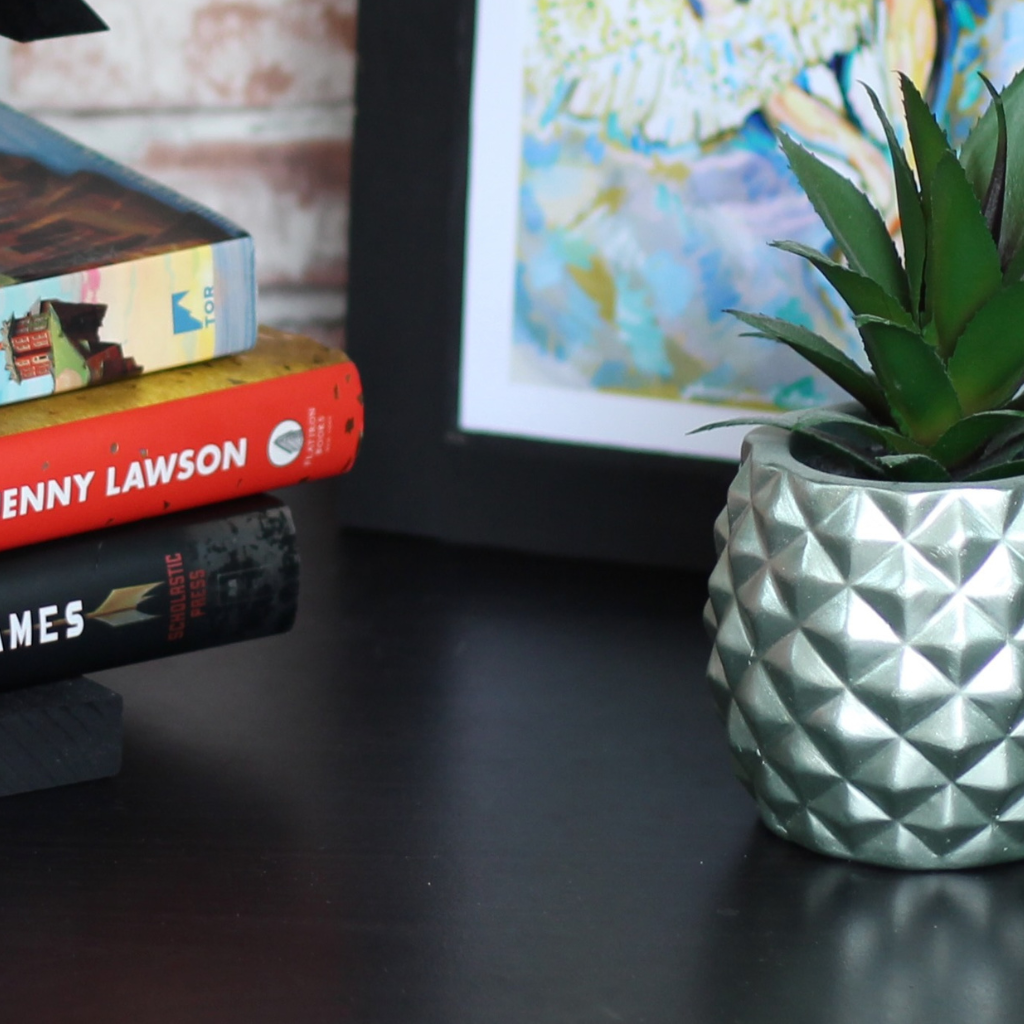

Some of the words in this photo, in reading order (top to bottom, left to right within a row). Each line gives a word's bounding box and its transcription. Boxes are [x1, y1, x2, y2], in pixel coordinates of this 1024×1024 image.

[203, 285, 215, 327] TOR
[106, 437, 248, 497] LAWSON
[165, 552, 186, 641] SCHOLASTIC
[189, 569, 206, 618] PRESS
